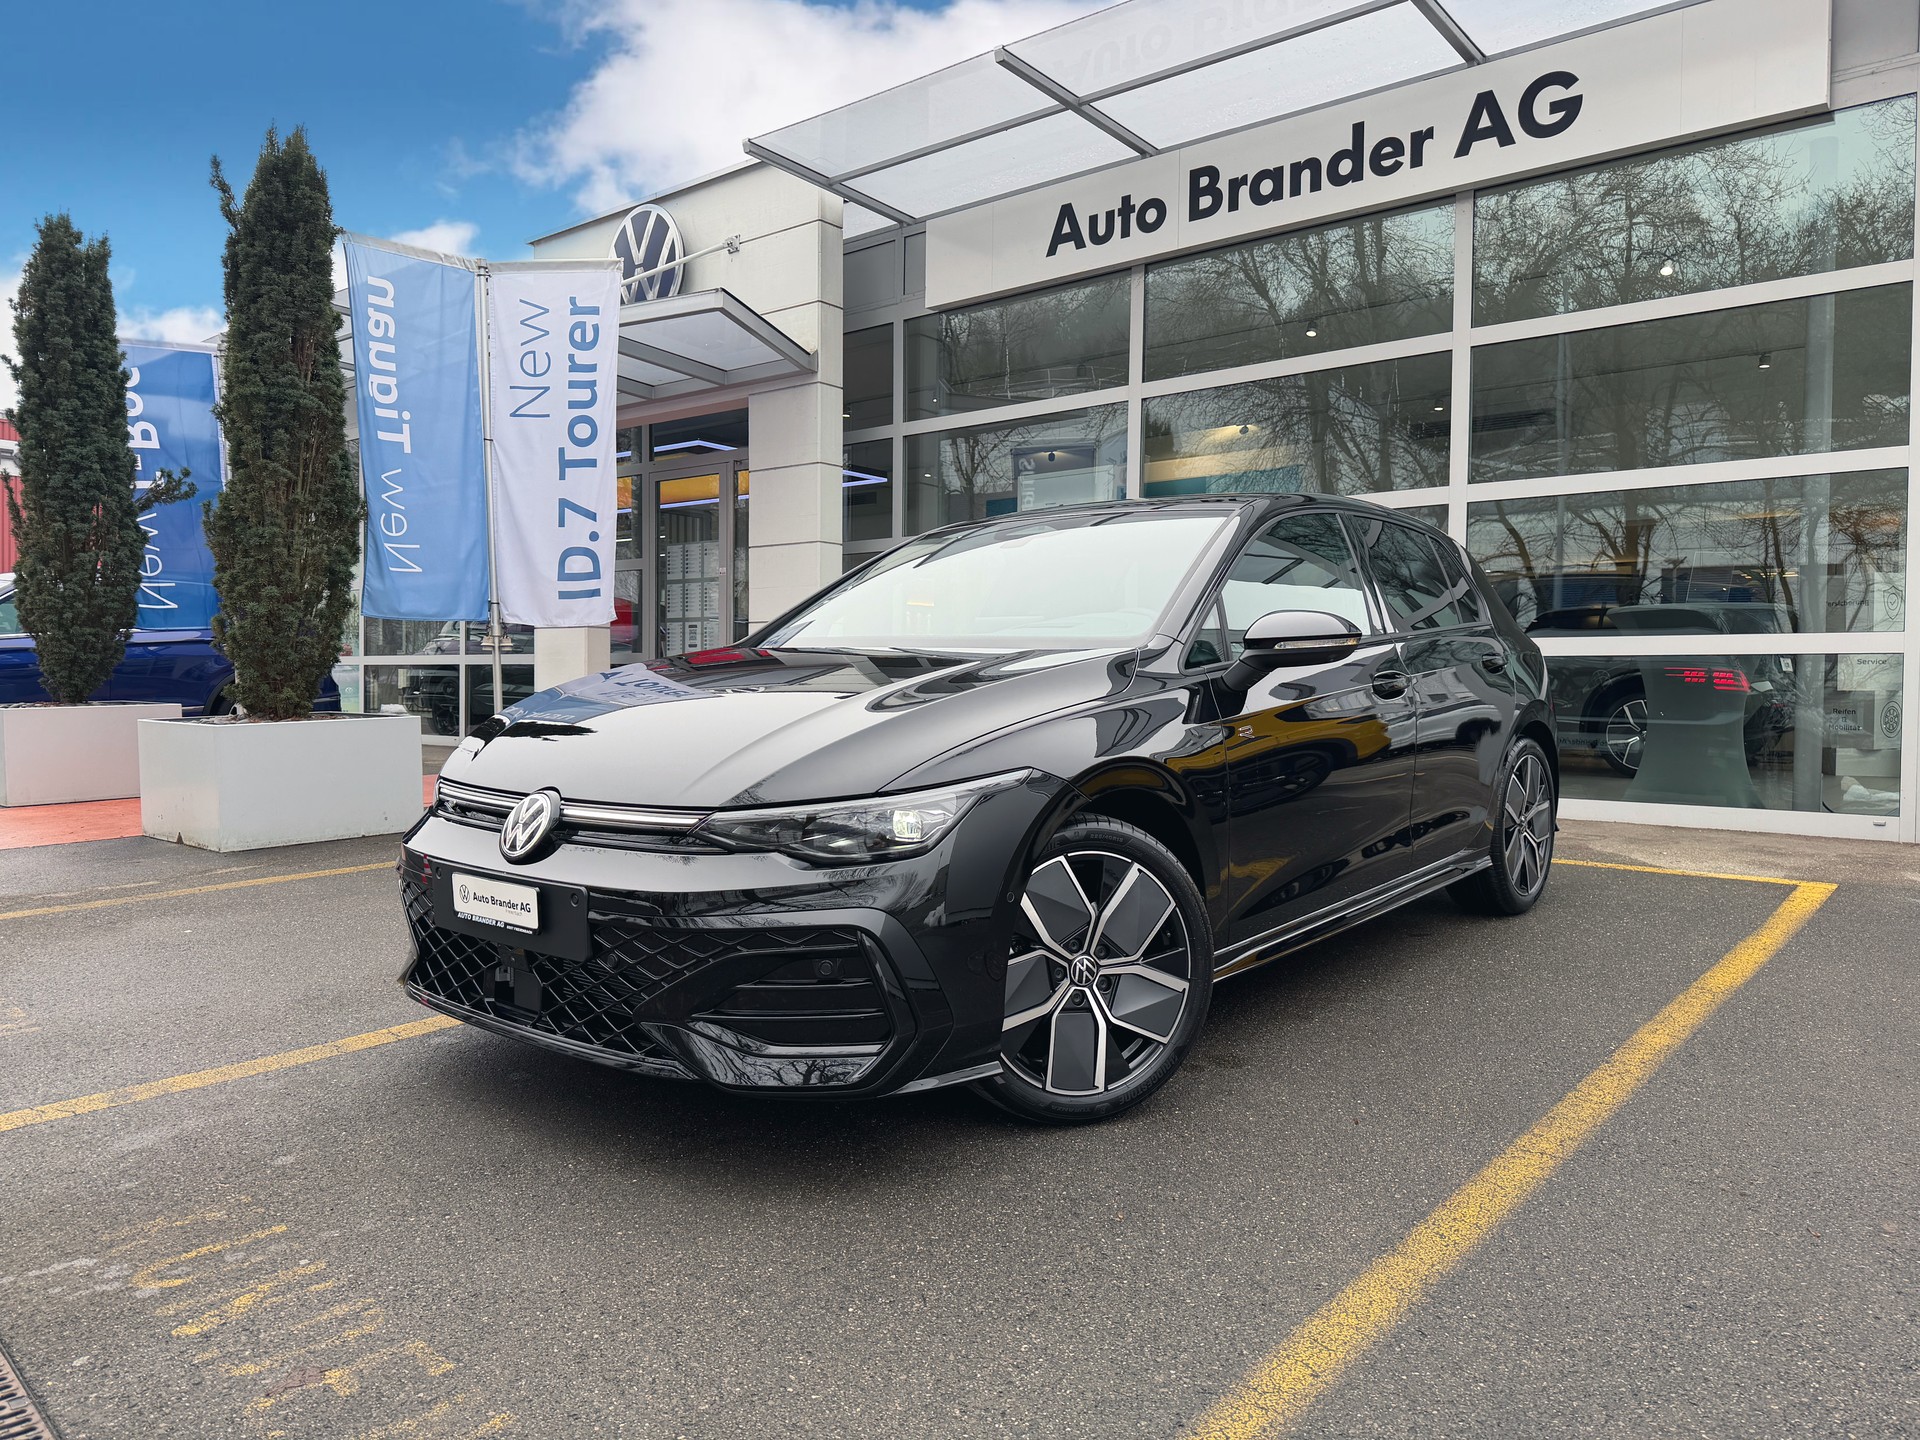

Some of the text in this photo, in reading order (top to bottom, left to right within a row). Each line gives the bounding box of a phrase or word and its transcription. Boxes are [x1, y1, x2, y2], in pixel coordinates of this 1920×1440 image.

[1046, 70, 1584, 257] Auto Brander AG
[509, 298, 551, 418] New
[557, 296, 601, 600] ID.7 Tourer
[1856, 658, 1888, 666] Service
[1832, 707, 1857, 716] Reifen
[473, 892, 490, 904] Auto
[490, 895, 519, 910] Brander
[520, 902, 531, 913] AG
[457, 911, 472, 920] AUTO
[472, 915, 496, 926] BRANDER
[496, 920, 505, 928] AG
